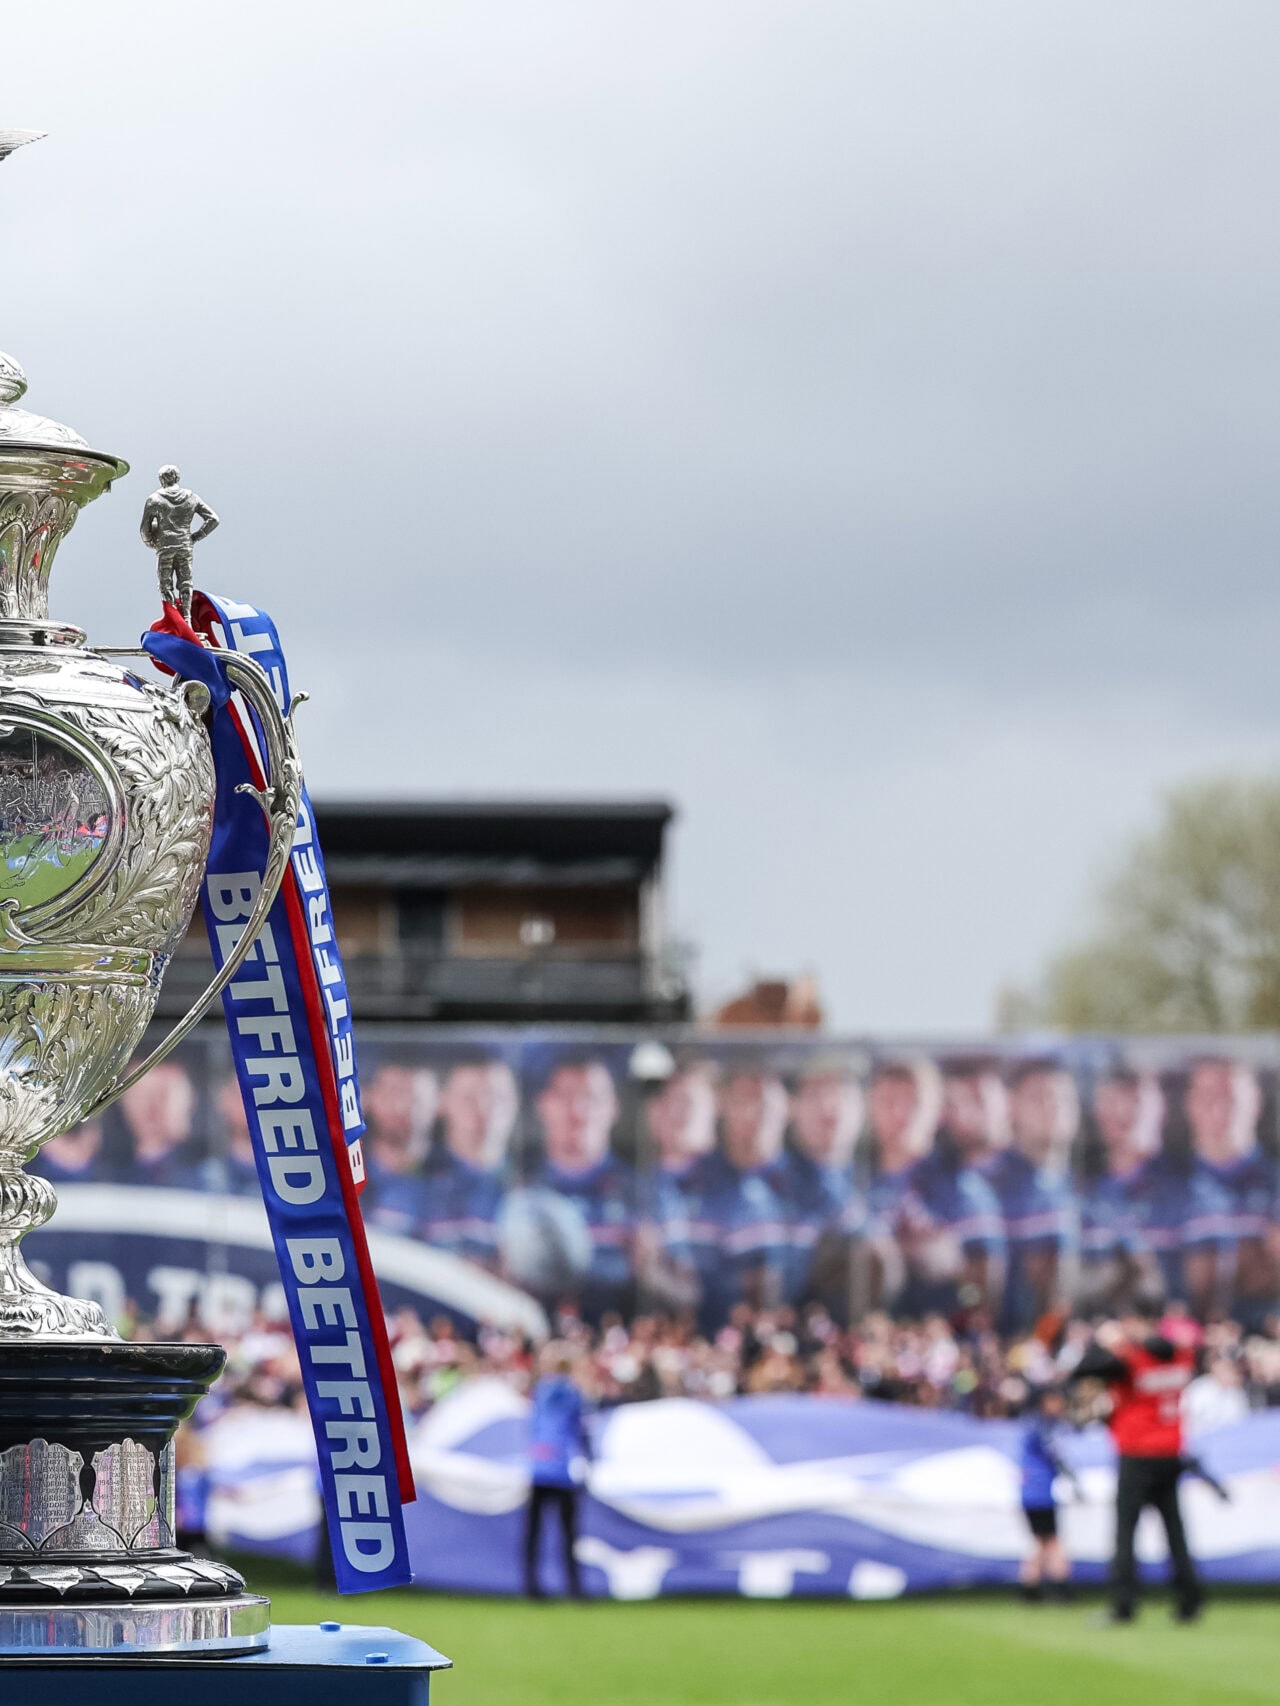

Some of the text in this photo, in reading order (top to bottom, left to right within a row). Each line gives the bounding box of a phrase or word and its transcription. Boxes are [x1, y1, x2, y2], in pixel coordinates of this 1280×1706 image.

[206, 870, 327, 1205] BETFRED
[285, 1237, 396, 1574] BETFRED
[293, 802, 362, 1131] BETFRED
